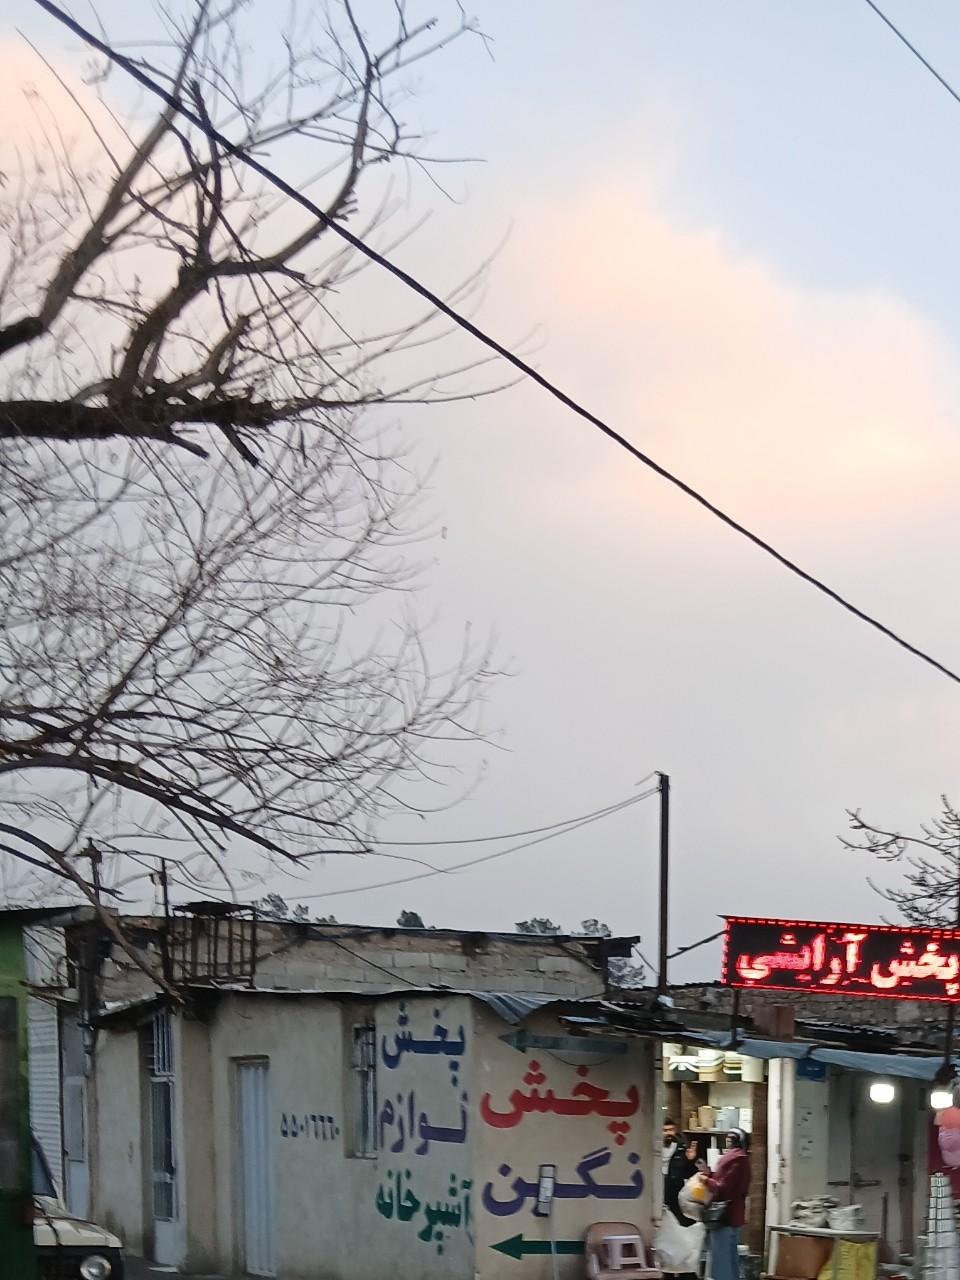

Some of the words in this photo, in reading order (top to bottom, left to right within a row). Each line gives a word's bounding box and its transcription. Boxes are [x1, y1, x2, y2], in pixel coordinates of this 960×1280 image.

[870, 941, 960, 996] پخش
[382, 1000, 465, 1087] پخش
[379, 1089, 469, 1156] لوازم
[480, 1059, 640, 1146] پخش
